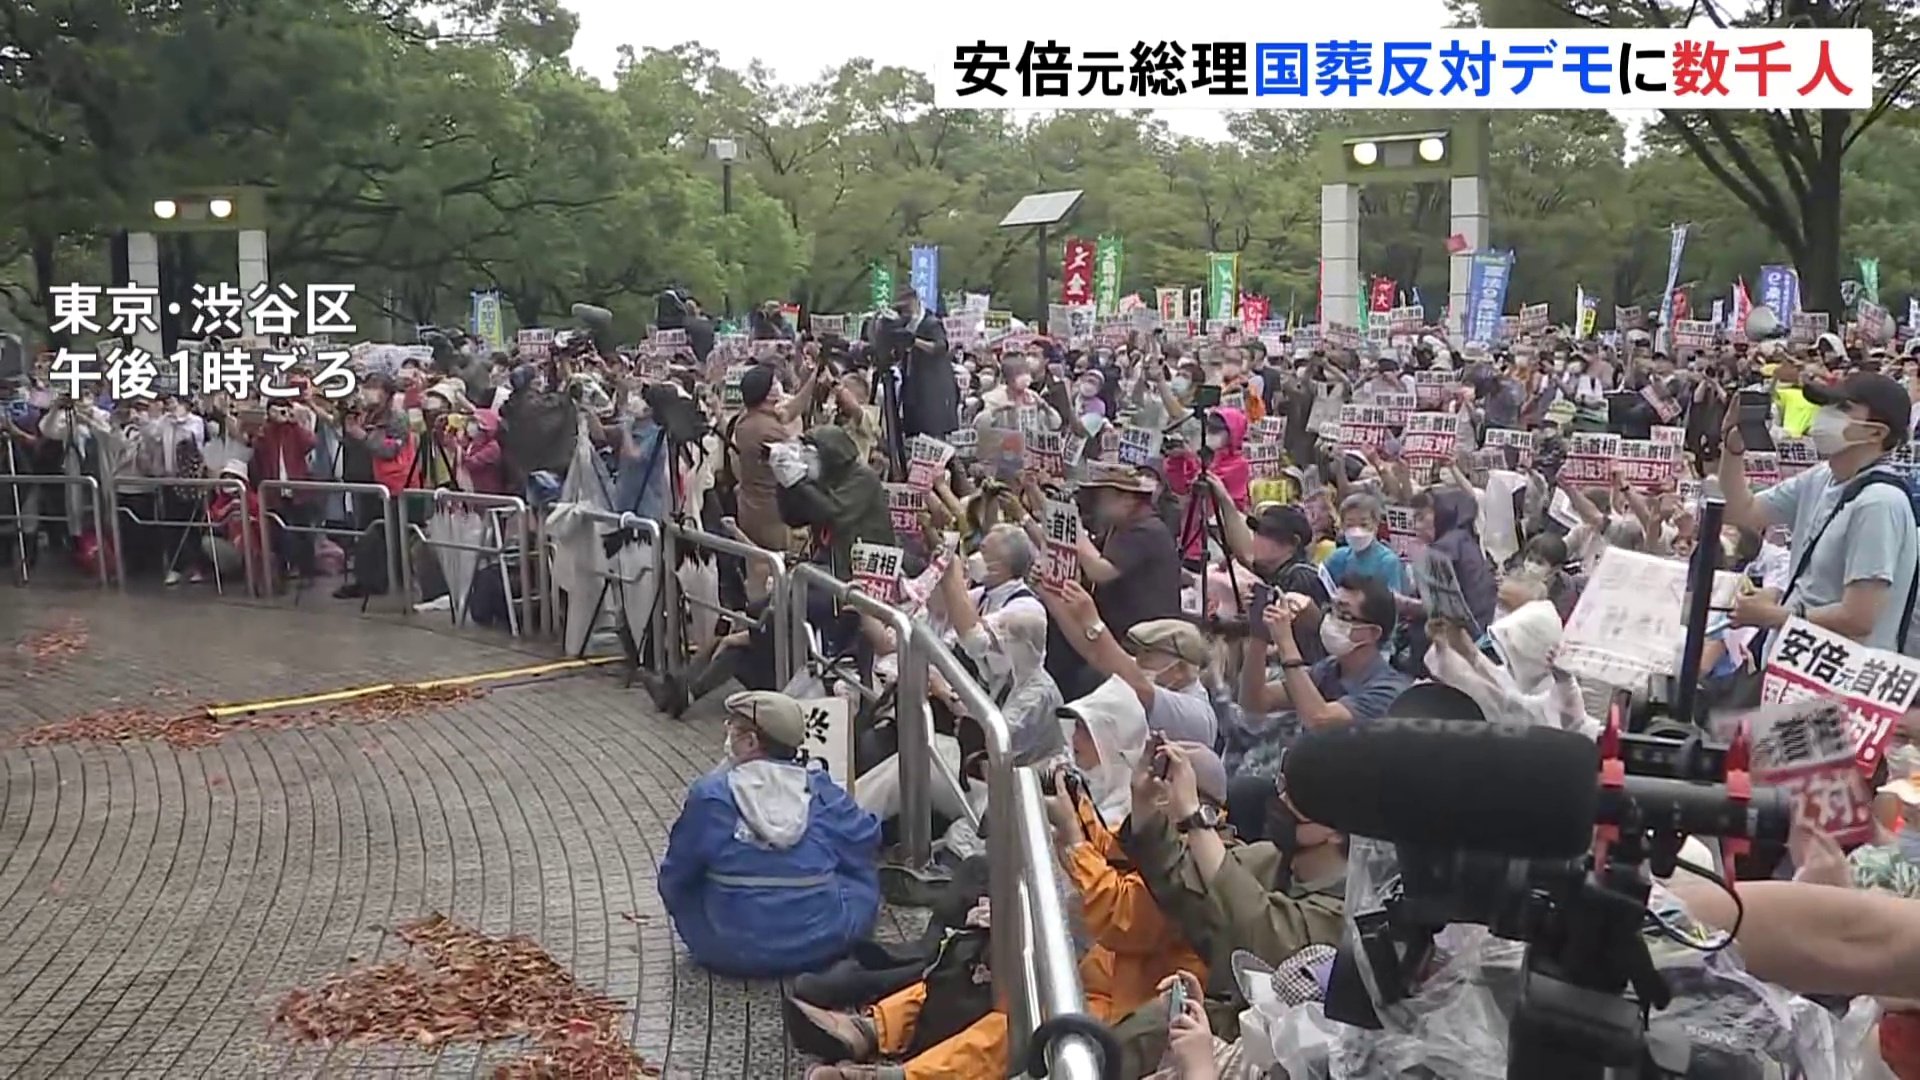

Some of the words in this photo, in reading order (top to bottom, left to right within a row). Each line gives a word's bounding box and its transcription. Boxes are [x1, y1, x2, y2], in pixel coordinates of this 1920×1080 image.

[1776, 627, 1919, 706] 安倍元首相
